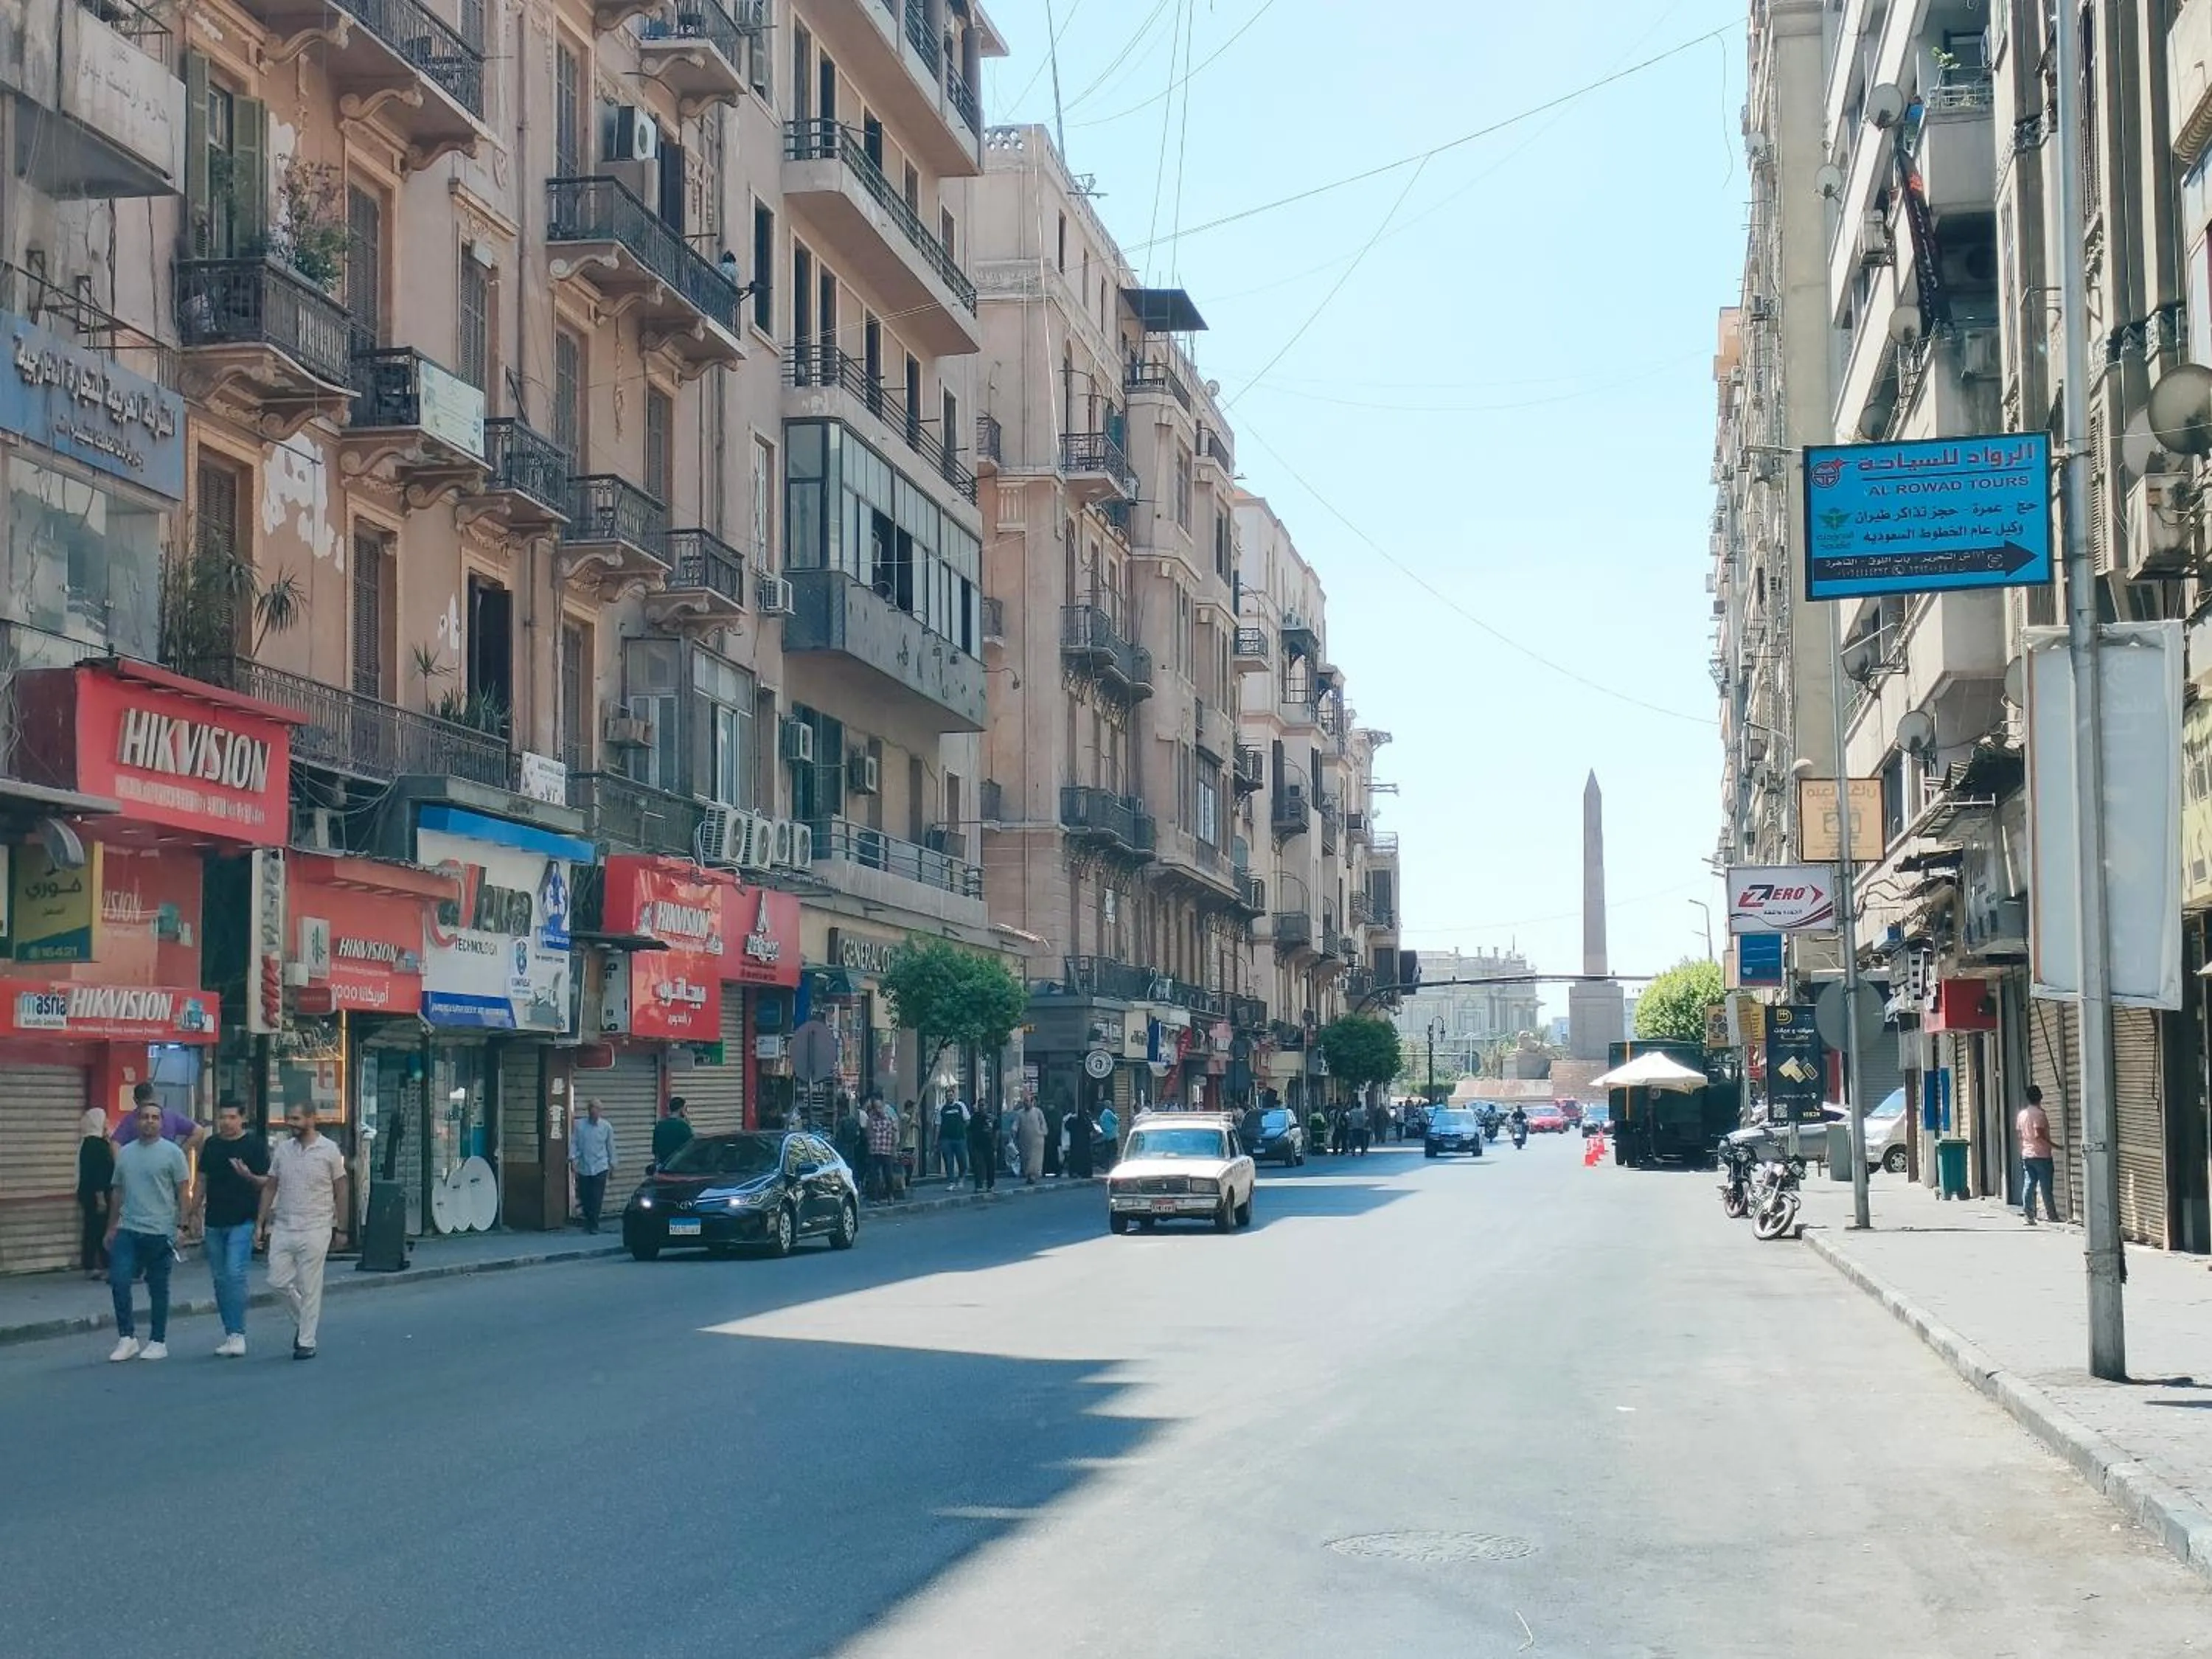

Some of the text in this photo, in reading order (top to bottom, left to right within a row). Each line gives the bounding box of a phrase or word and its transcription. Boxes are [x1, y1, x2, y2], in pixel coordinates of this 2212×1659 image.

[1857, 442, 2035, 472] الرواد للسياحة
[1869, 476, 2029, 496] AL ROWAD TOURS
[1855, 501, 2038, 524] حج عمرة حجز تذاكر طيران
[1919, 524, 1966, 540] الخطوط
[1971, 524, 1992, 539] عام
[1995, 520, 2023, 537] وكيل
[119, 707, 271, 793] HIKVISION
[1739, 884, 1806, 908] ZERO
[338, 937, 400, 963] HIKVISION
[72, 987, 174, 1021] HIKVISION
